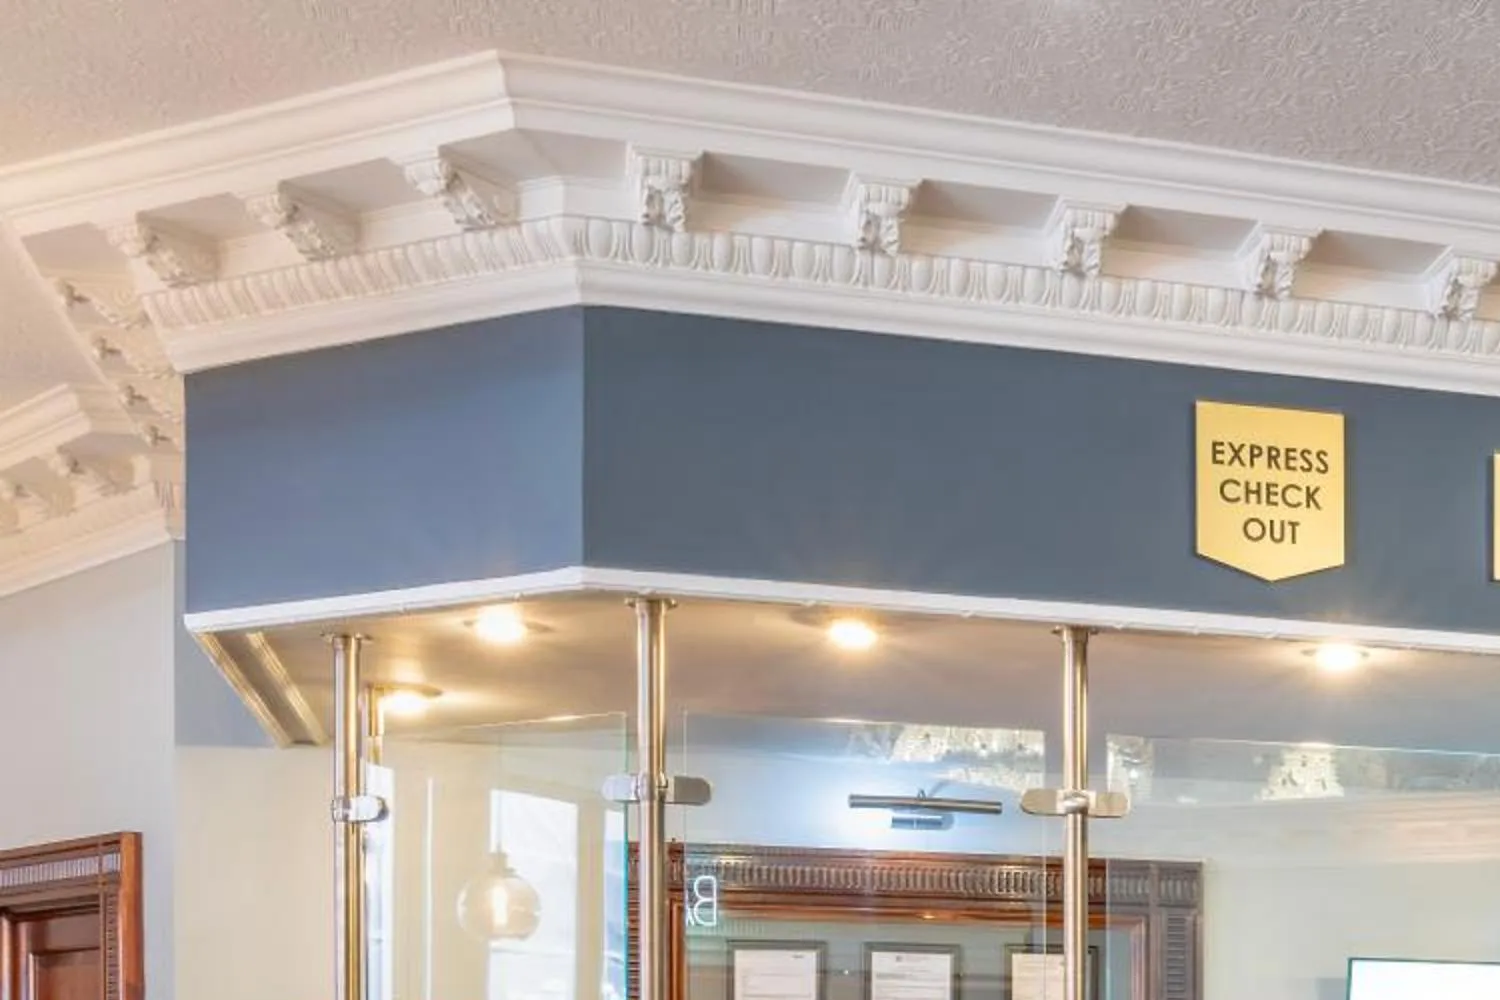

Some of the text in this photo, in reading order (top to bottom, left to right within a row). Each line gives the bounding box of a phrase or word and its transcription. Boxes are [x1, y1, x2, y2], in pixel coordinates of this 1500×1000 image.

[1211, 440, 1329, 474] EXPRESS
[1219, 478, 1322, 511] CHECK
[1243, 517, 1301, 544] OUT
